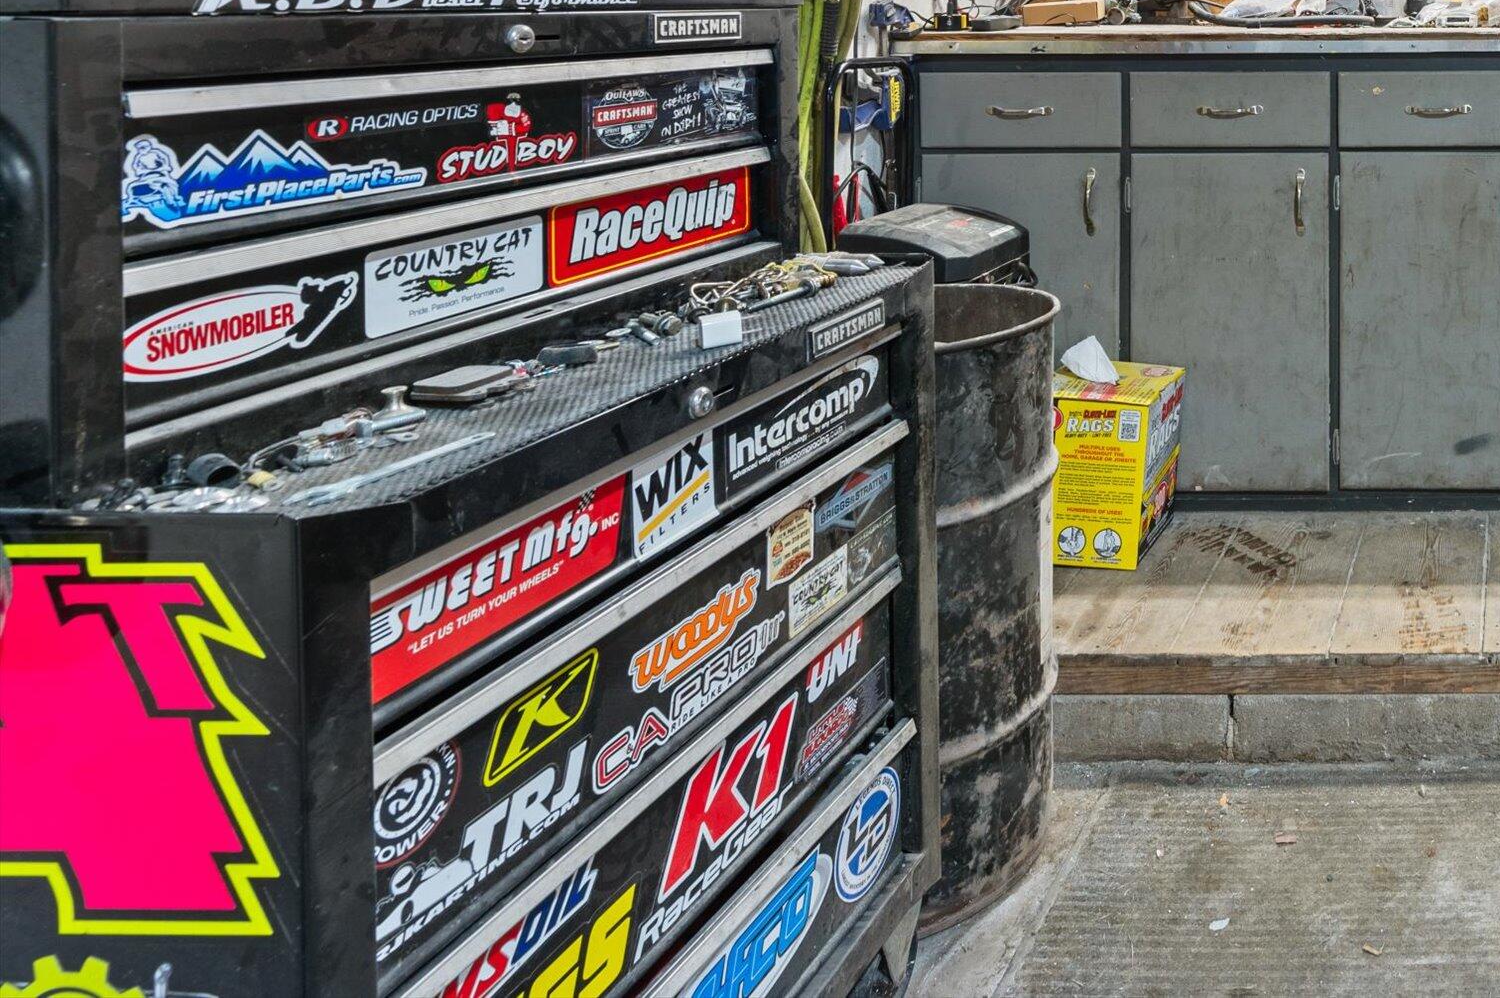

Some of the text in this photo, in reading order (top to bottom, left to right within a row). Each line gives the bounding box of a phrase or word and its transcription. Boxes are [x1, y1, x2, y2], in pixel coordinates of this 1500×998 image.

[659, 17, 738, 36] CRAFTSMAN
[350, 103, 478, 133] RACING OPTICS
[597, 105, 654, 122] CRAFTSMAN
[441, 136, 575, 180] STUD BOY
[569, 179, 737, 265] RaceQuip
[375, 227, 533, 282] COUNTRY CAT
[146, 302, 294, 362] SNOWMOBILER
[150, 320, 194, 336] AMERICAN
[816, 308, 883, 350] CRAFTSMAN
[728, 378, 865, 473] Intercomp
[1066, 416, 1115, 433] RAGS
[635, 434, 709, 522] WIX
[601, 511, 620, 531] INC
[639, 483, 710, 555] FILTERS
[437, 616, 454, 637] US
[457, 598, 486, 629] TURN
[488, 585, 518, 612] YOUR
[463, 740, 588, 875] TRJ
[662, 699, 797, 896] K1
[634, 782, 793, 965] RaceGear
